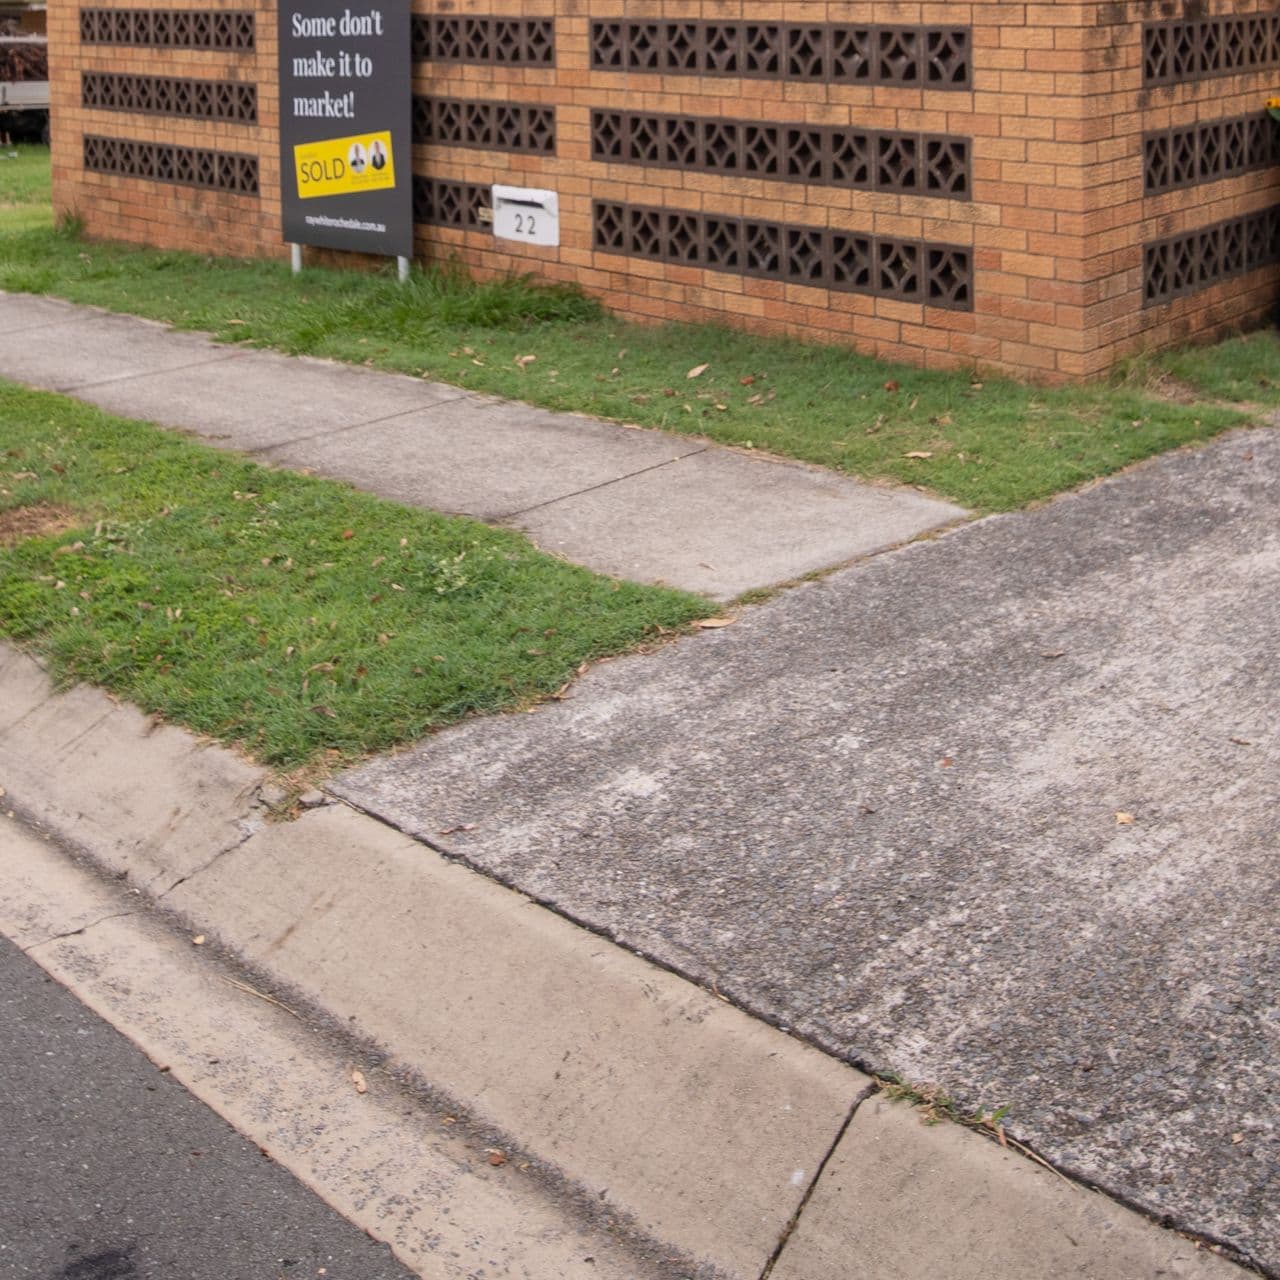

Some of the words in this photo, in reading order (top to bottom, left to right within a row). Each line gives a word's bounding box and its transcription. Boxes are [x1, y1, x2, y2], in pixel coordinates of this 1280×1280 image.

[292, 12, 336, 37] Some
[340, 9, 383, 36] don't
[293, 50, 335, 77] make
[339, 50, 352, 77] it
[355, 53, 373, 77] to
[293, 90, 355, 118] market!
[301, 158, 345, 183] SOLD
[515, 213, 536, 235] 22
